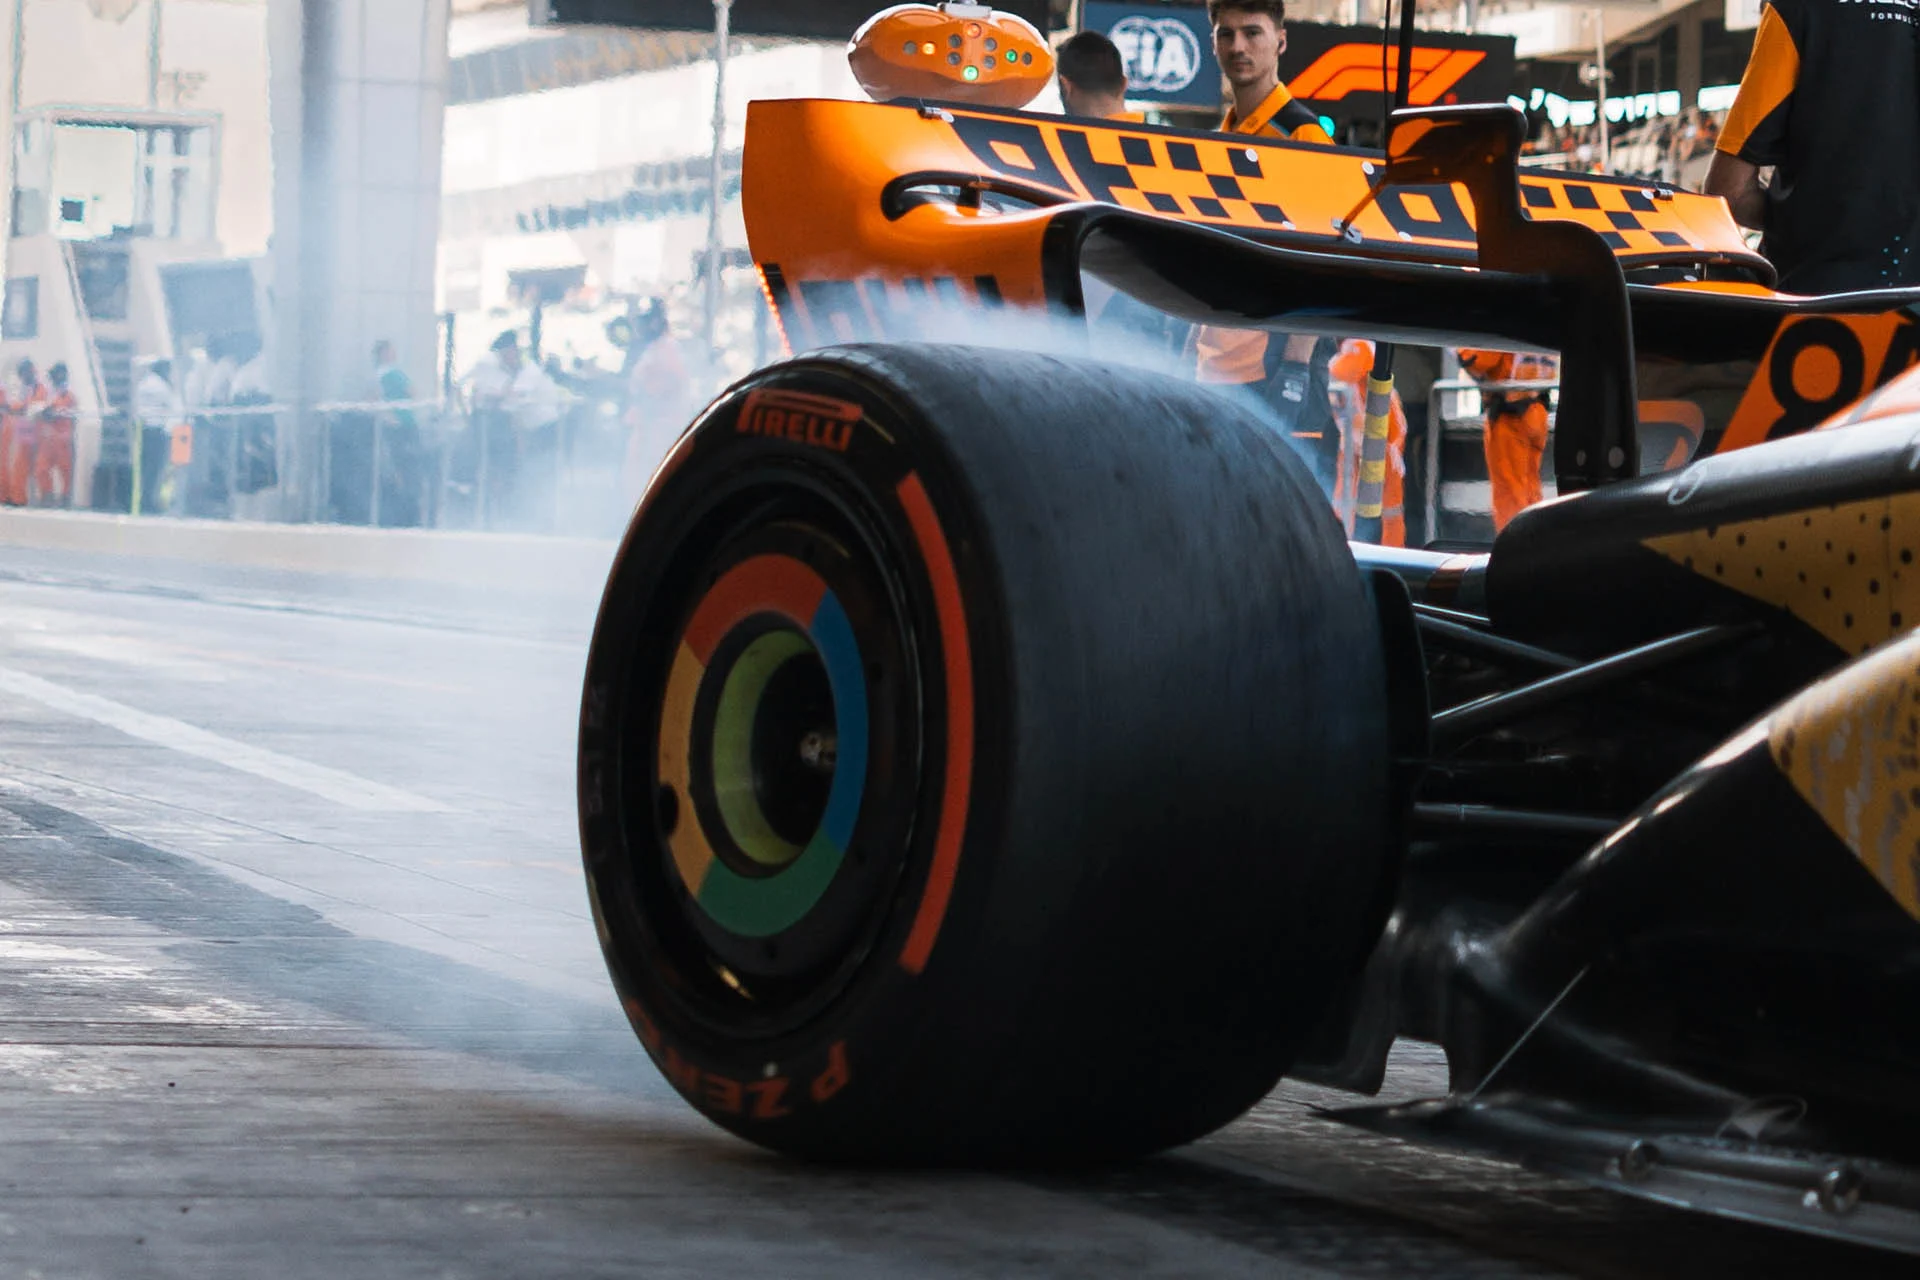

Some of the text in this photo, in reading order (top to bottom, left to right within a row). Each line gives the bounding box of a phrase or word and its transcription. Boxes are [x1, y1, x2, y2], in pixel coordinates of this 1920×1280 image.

[1870, 12, 1919, 26] FORMUL
[1111, 31, 1192, 79] FIA
[1287, 43, 1487, 105] F1
[736, 388, 862, 453] PIRELLI
[810, 1040, 850, 1102] P
